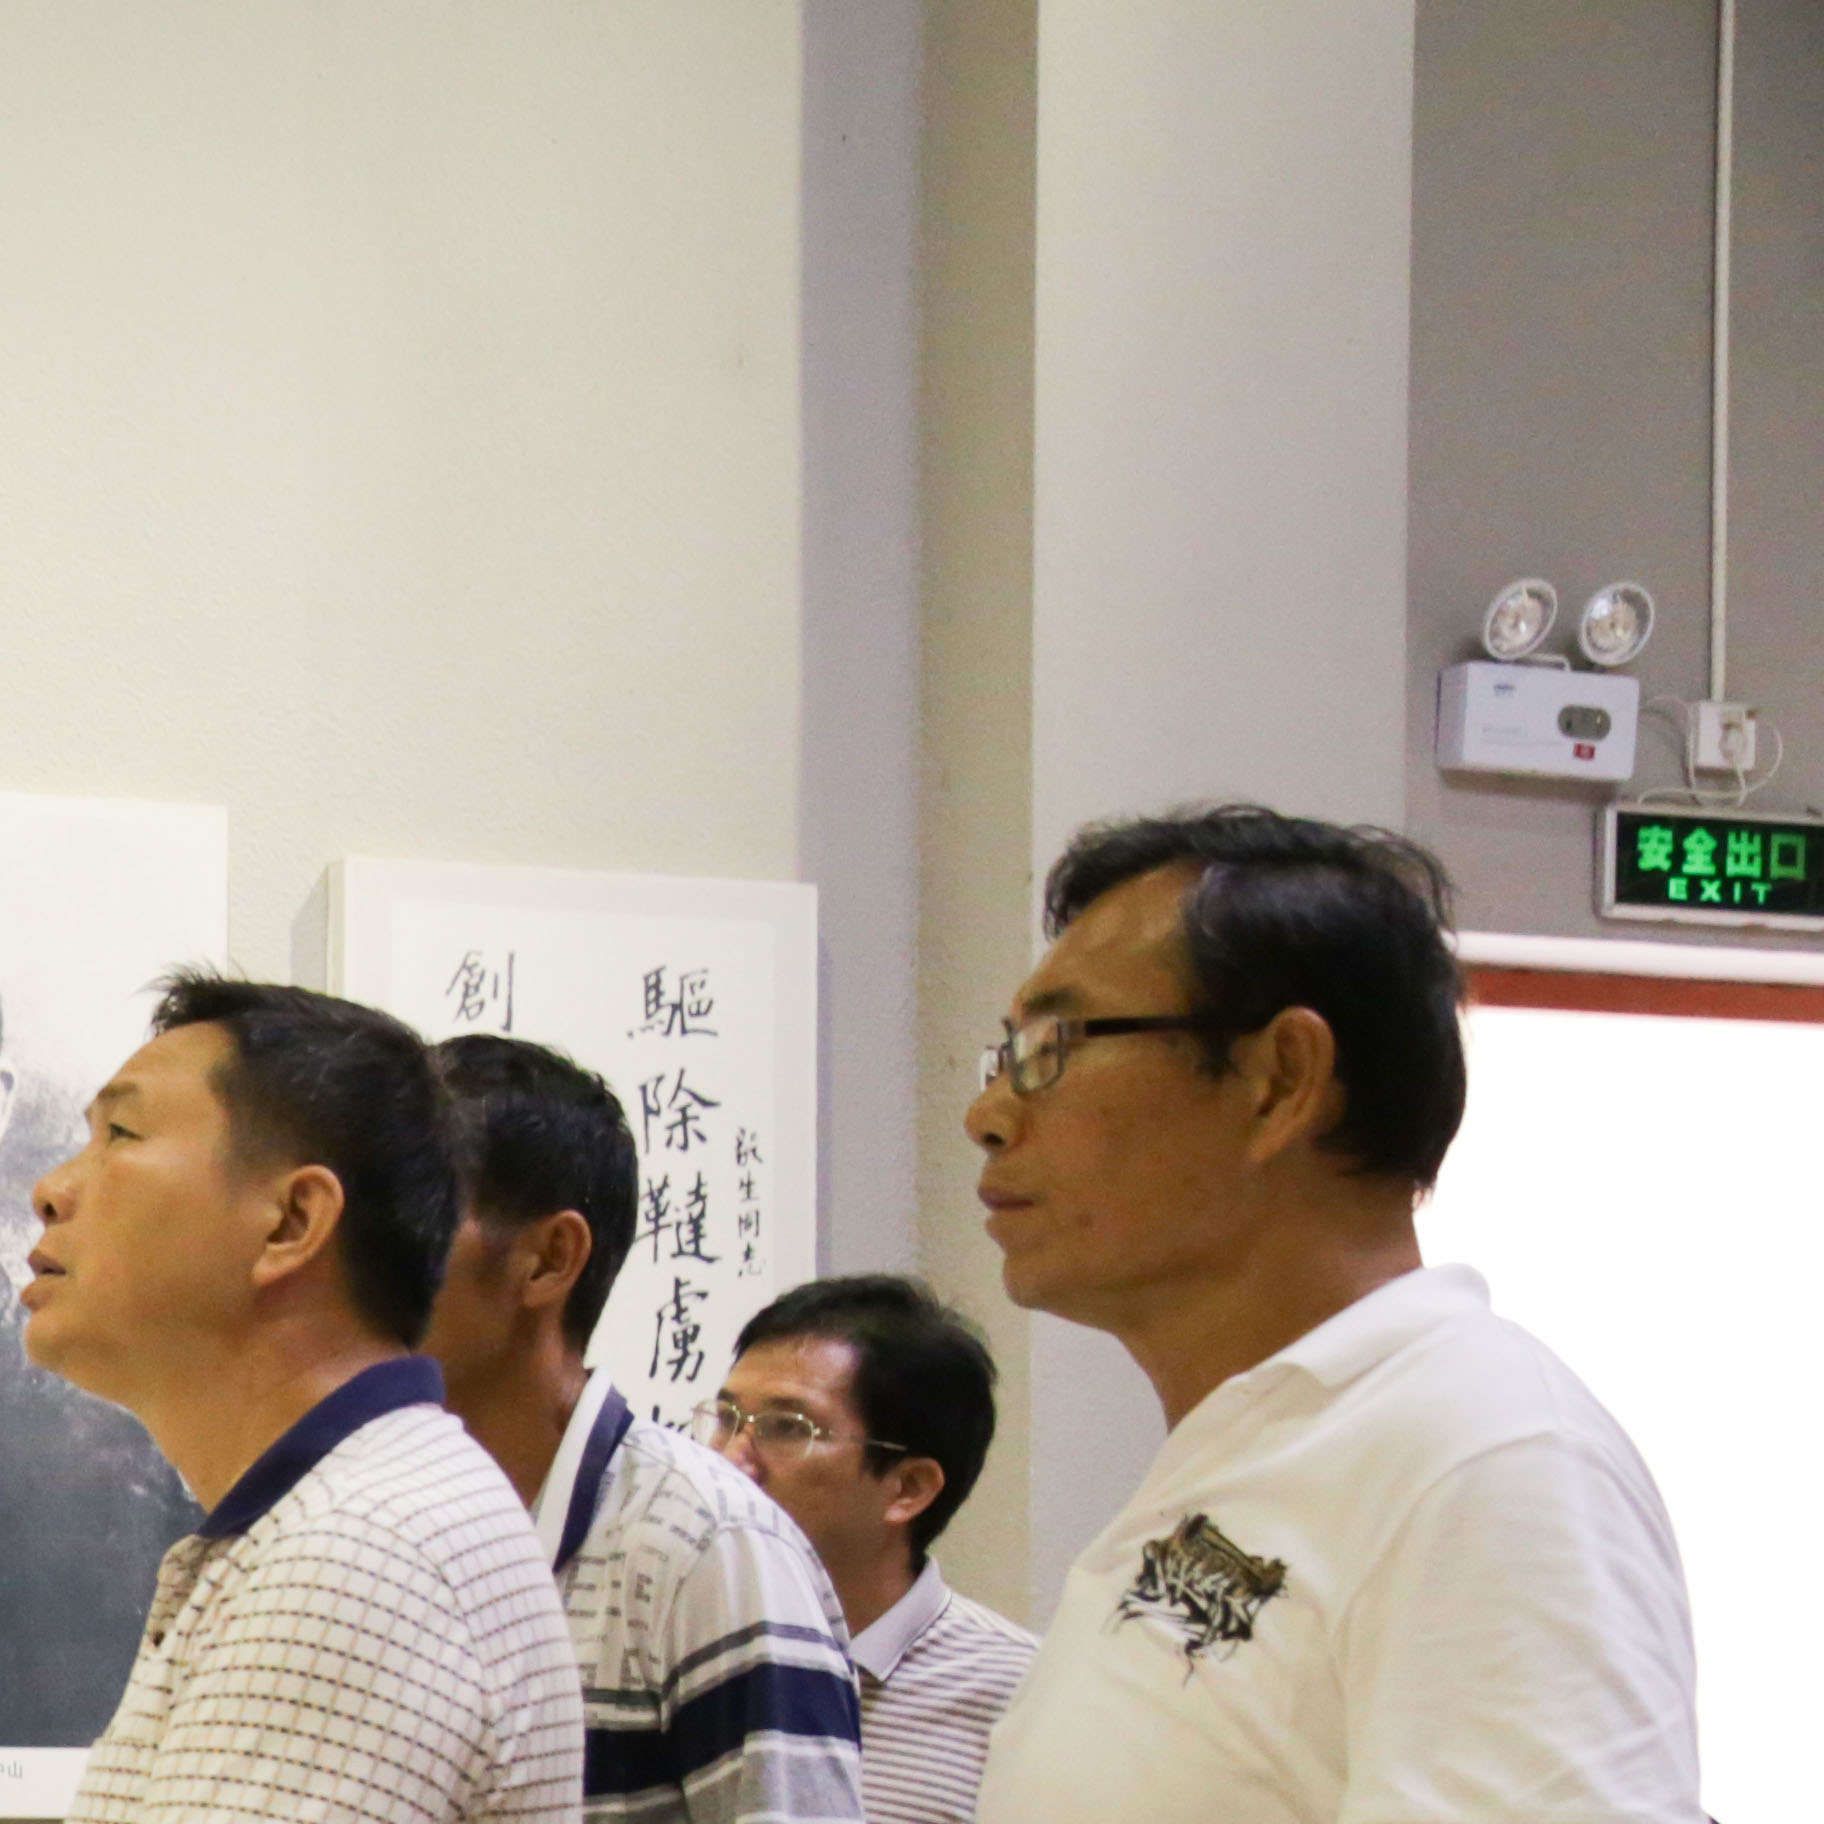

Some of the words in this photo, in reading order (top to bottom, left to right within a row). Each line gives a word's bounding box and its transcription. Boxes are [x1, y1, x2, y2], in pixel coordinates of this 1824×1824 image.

[1637, 825, 1807, 880] 安全出口
[1668, 876, 1773, 905] EXIT
[445, 949, 515, 1033] 創
